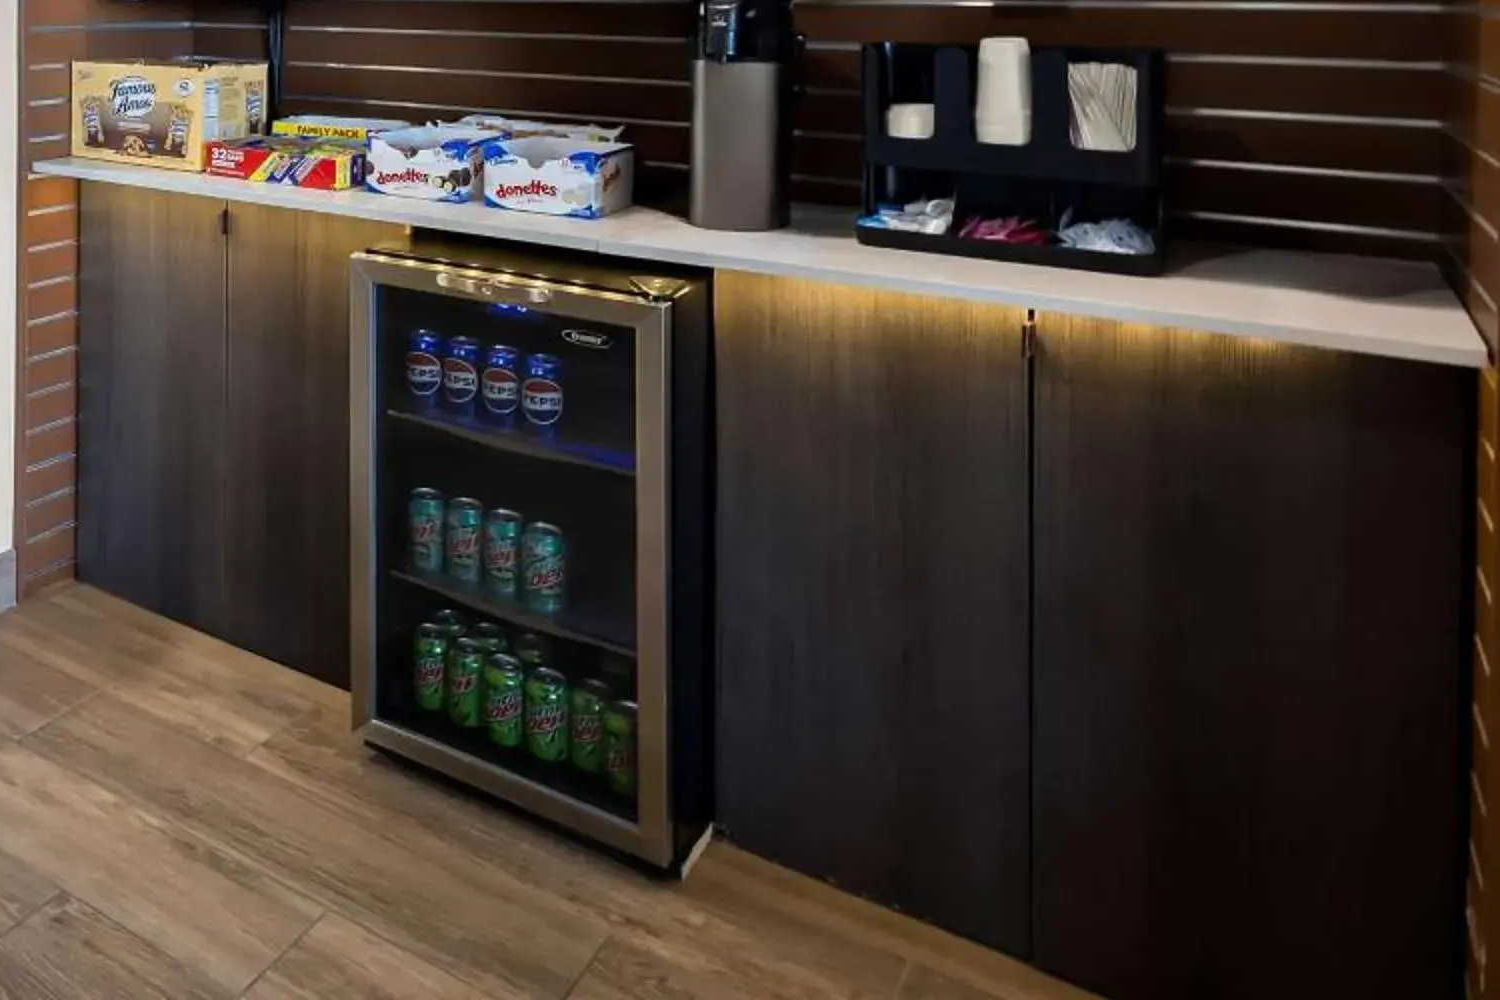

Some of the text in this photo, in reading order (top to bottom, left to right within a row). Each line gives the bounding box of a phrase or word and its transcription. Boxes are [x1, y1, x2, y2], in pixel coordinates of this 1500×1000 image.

[109, 79, 156, 101] Famous
[115, 98, 152, 116] Amos
[297, 125, 330, 137] FAMILY
[211, 147, 227, 160] 32
[376, 167, 429, 184] donettes
[495, 179, 559, 200] donettes
